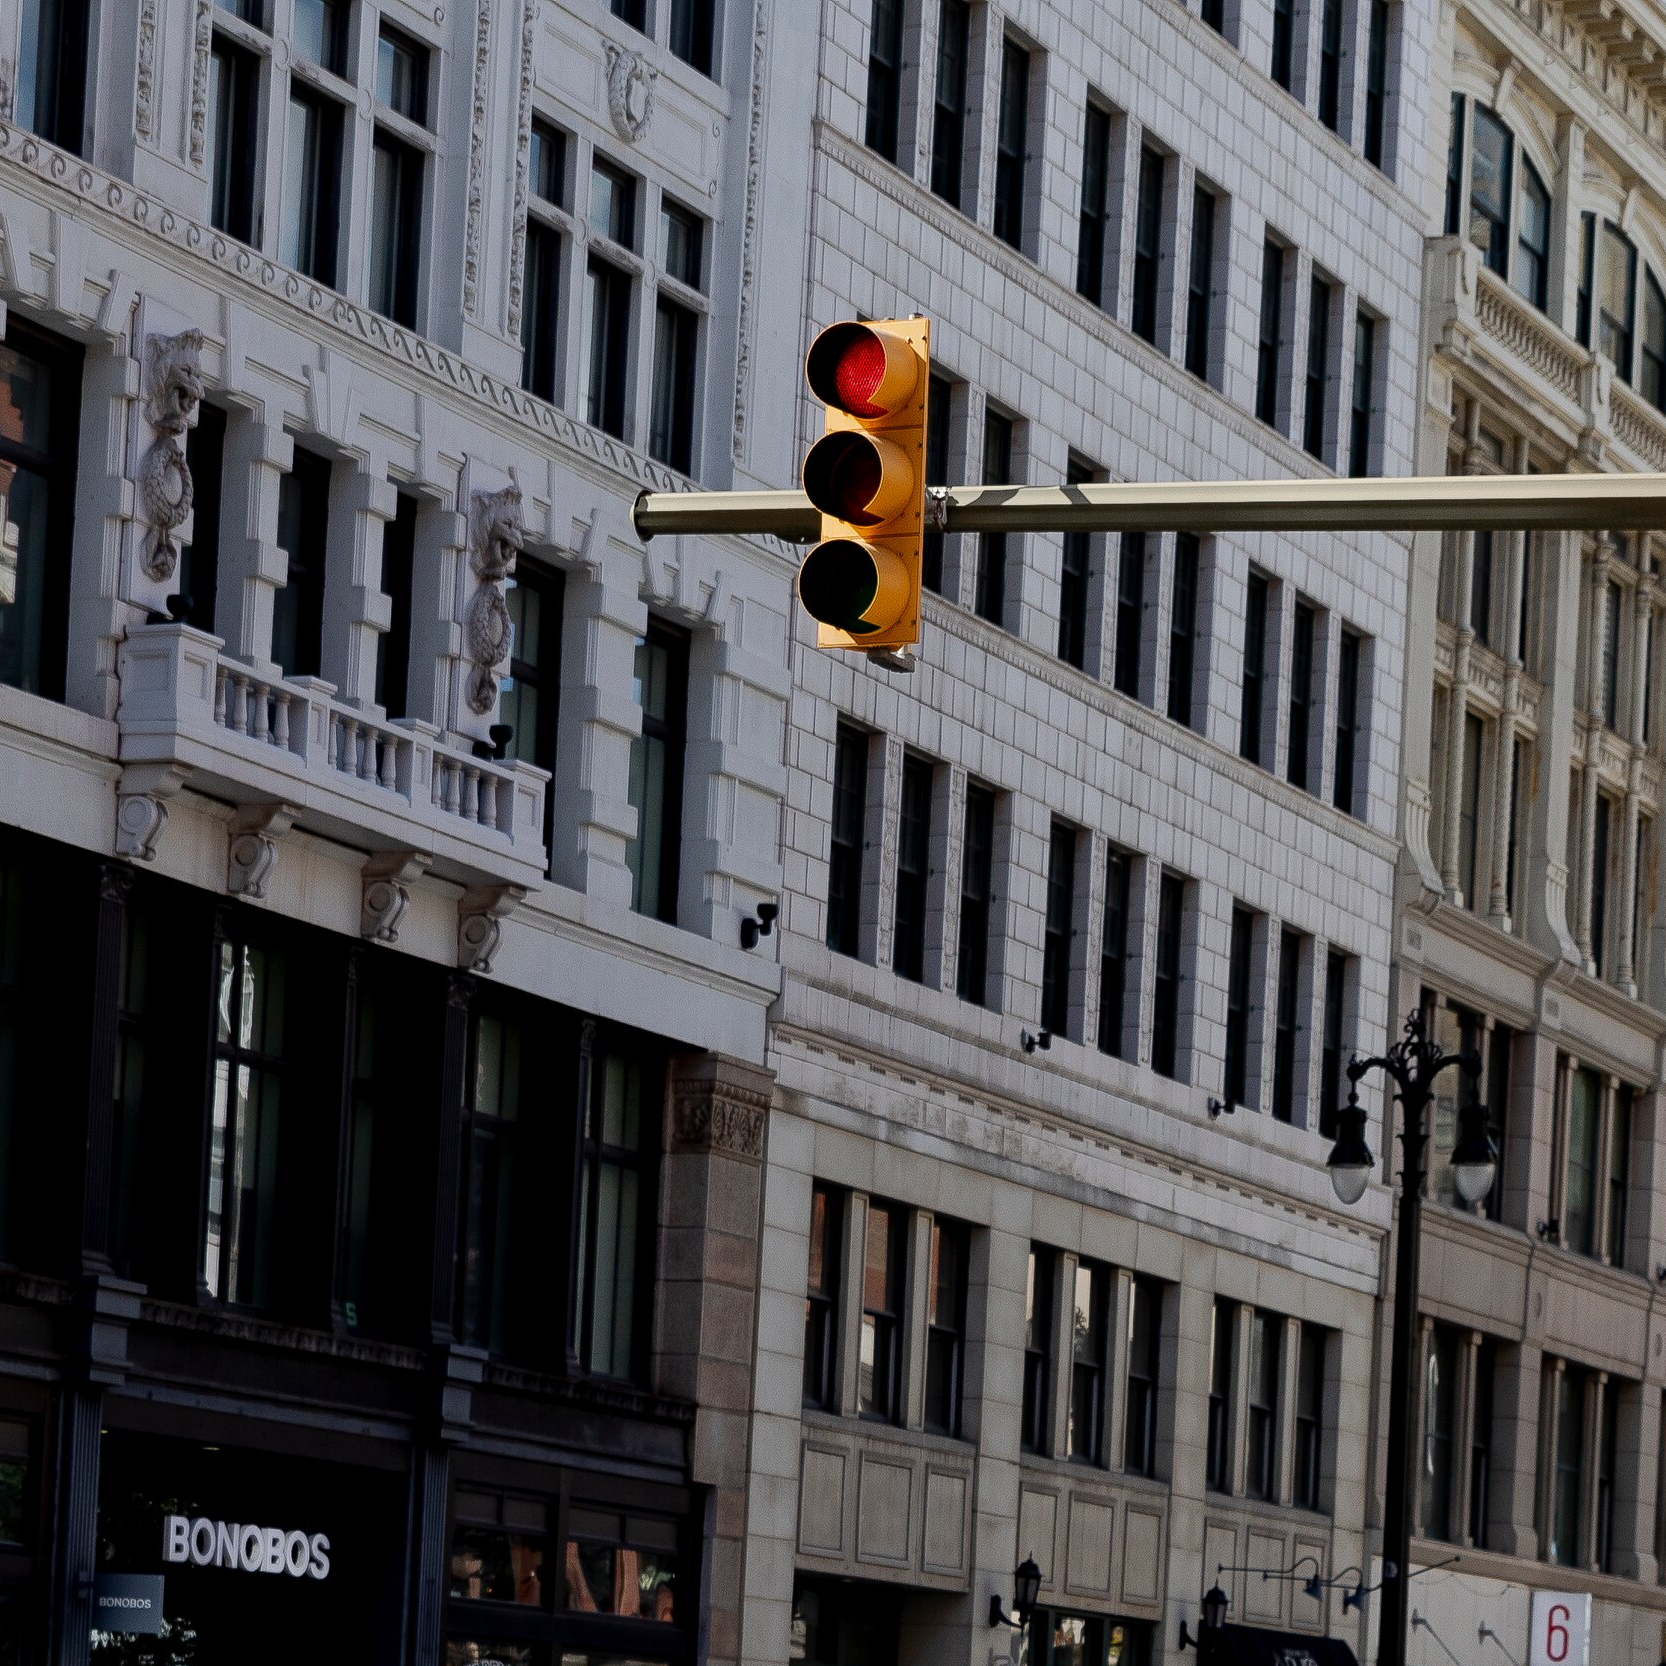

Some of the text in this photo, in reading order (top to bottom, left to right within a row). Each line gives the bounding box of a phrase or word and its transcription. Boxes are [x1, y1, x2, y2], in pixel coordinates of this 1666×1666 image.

[162, 1514, 331, 1580] BONOBOS
[98, 1596, 152, 1609] BONOBOS
[1545, 1603, 1571, 1663] 6
